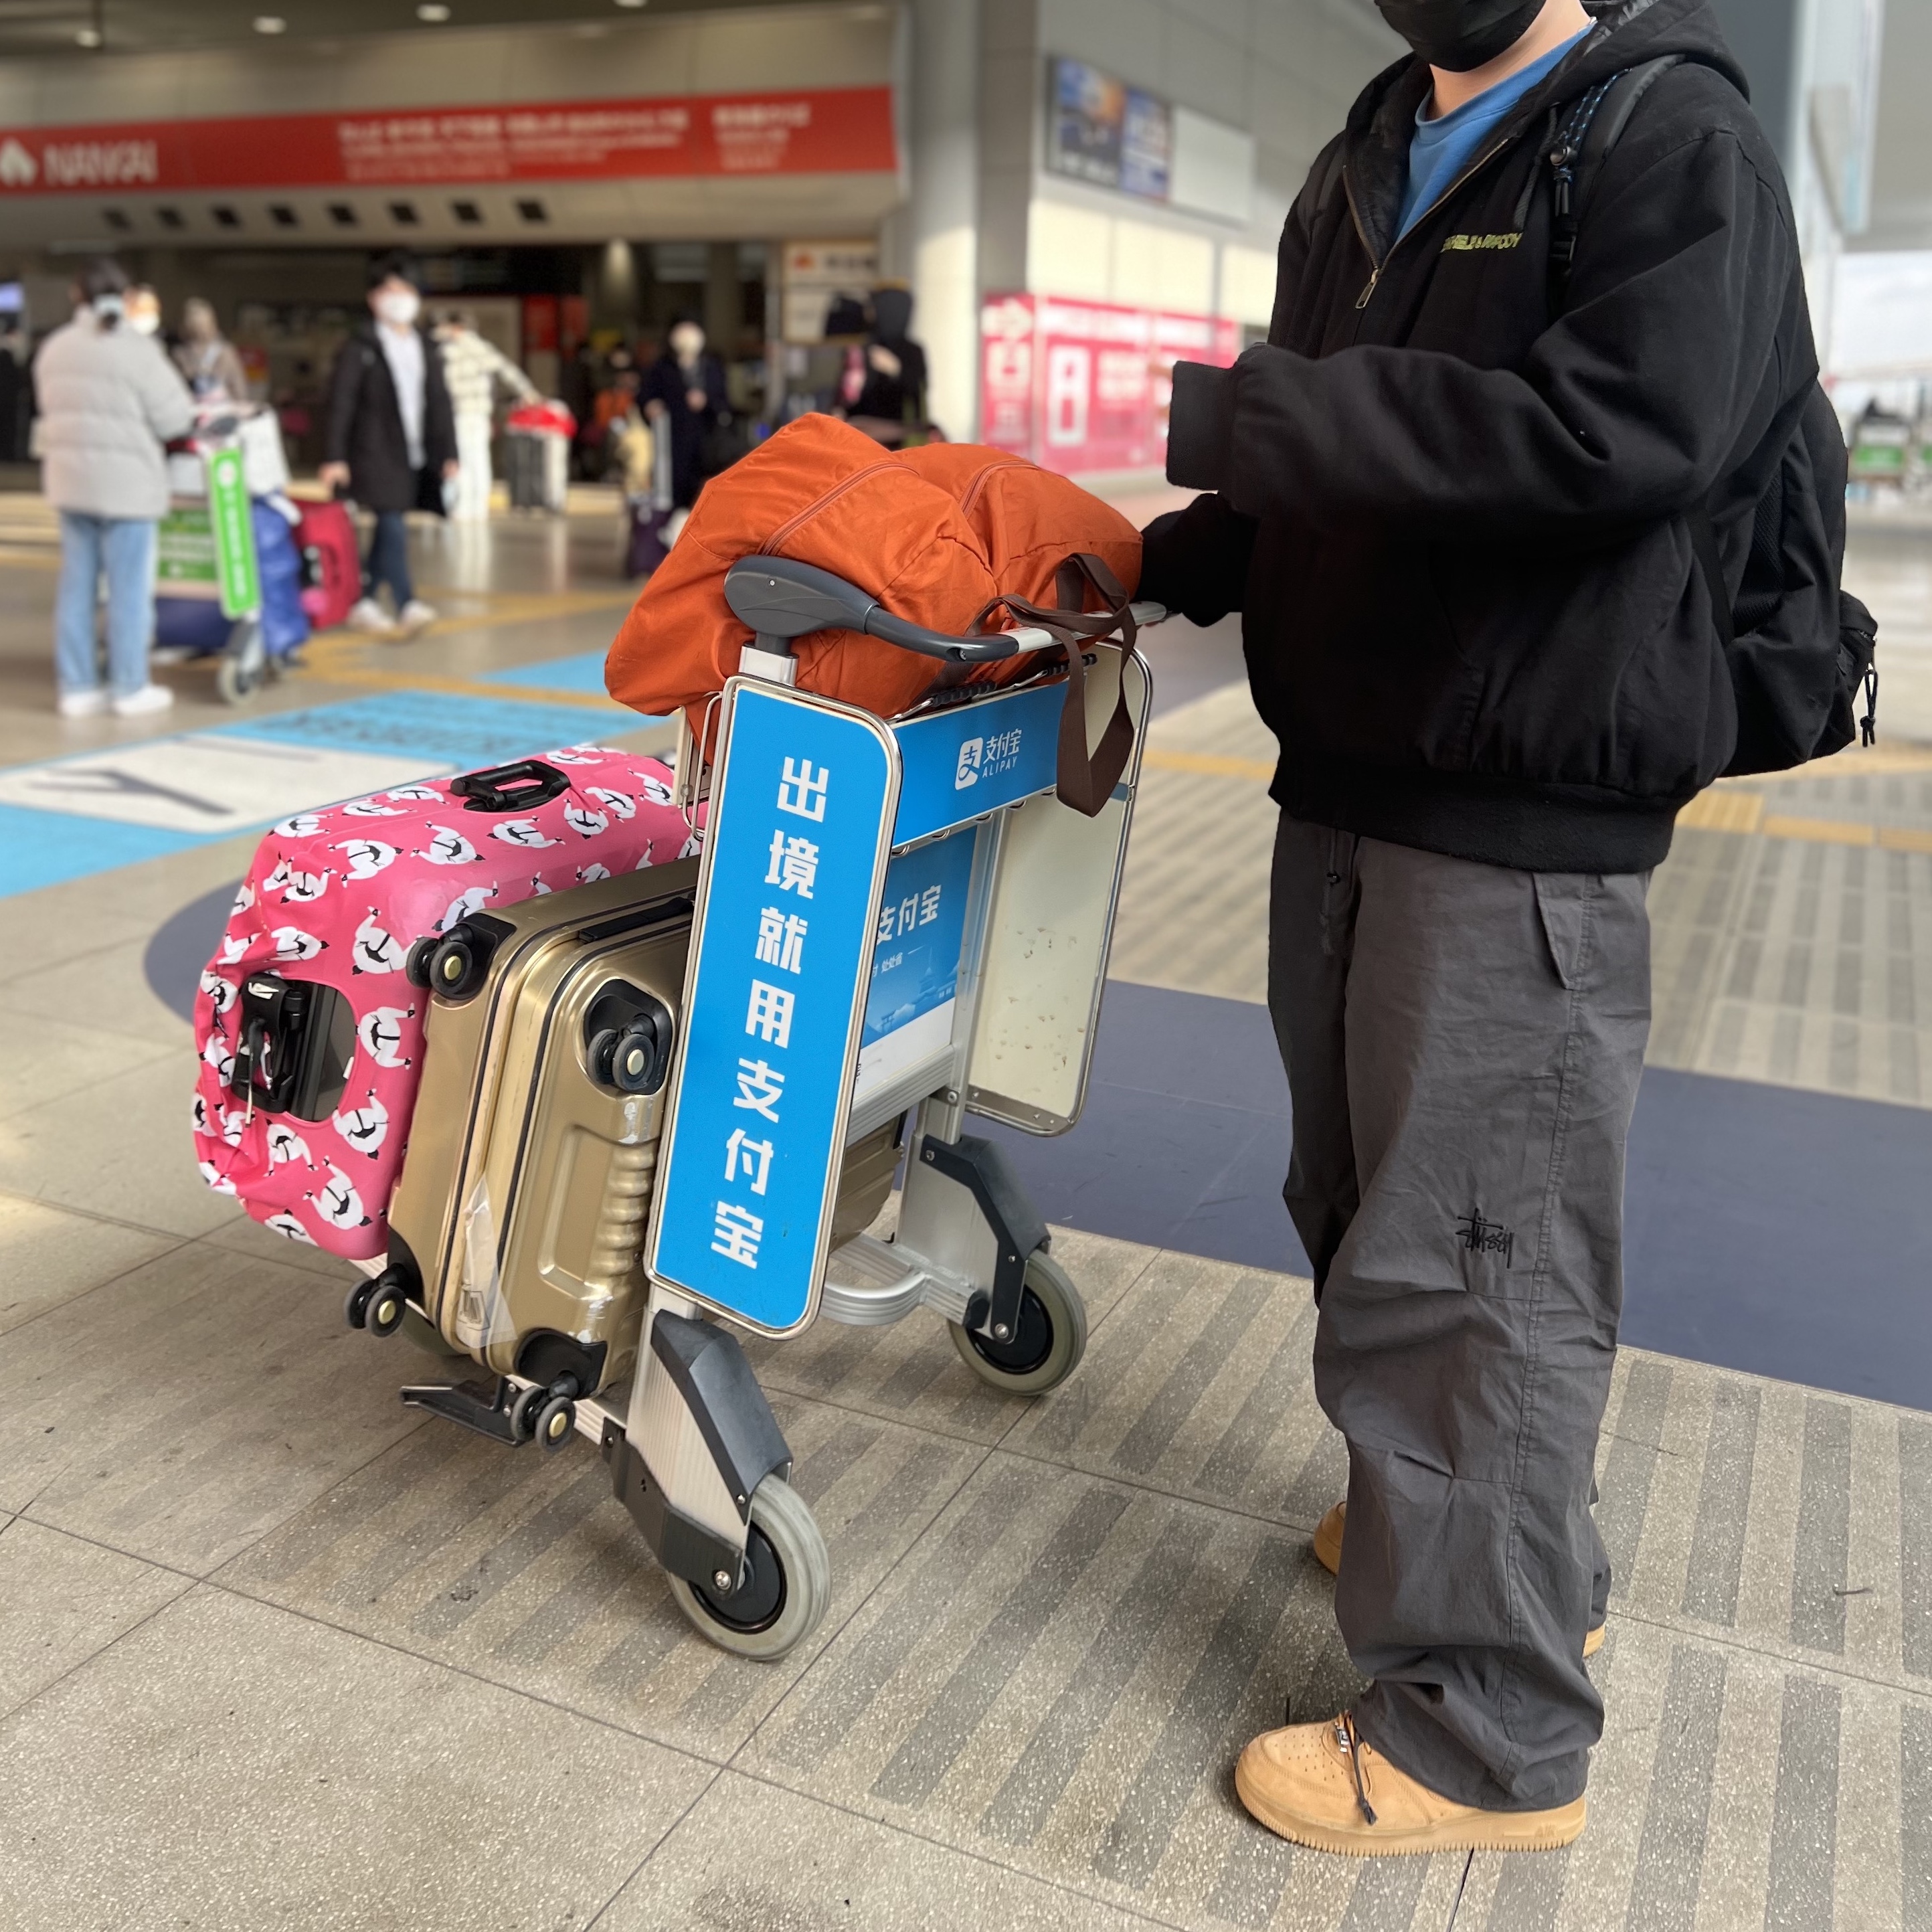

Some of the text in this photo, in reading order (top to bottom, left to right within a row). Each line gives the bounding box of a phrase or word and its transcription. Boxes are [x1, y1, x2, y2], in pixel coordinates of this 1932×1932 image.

[982, 728, 1023, 764] 支付宝
[982, 756, 1018, 779] ALIPAY
[876, 884, 942, 946] 支付宝
[711, 756, 829, 1269] 出境就用支付宝
